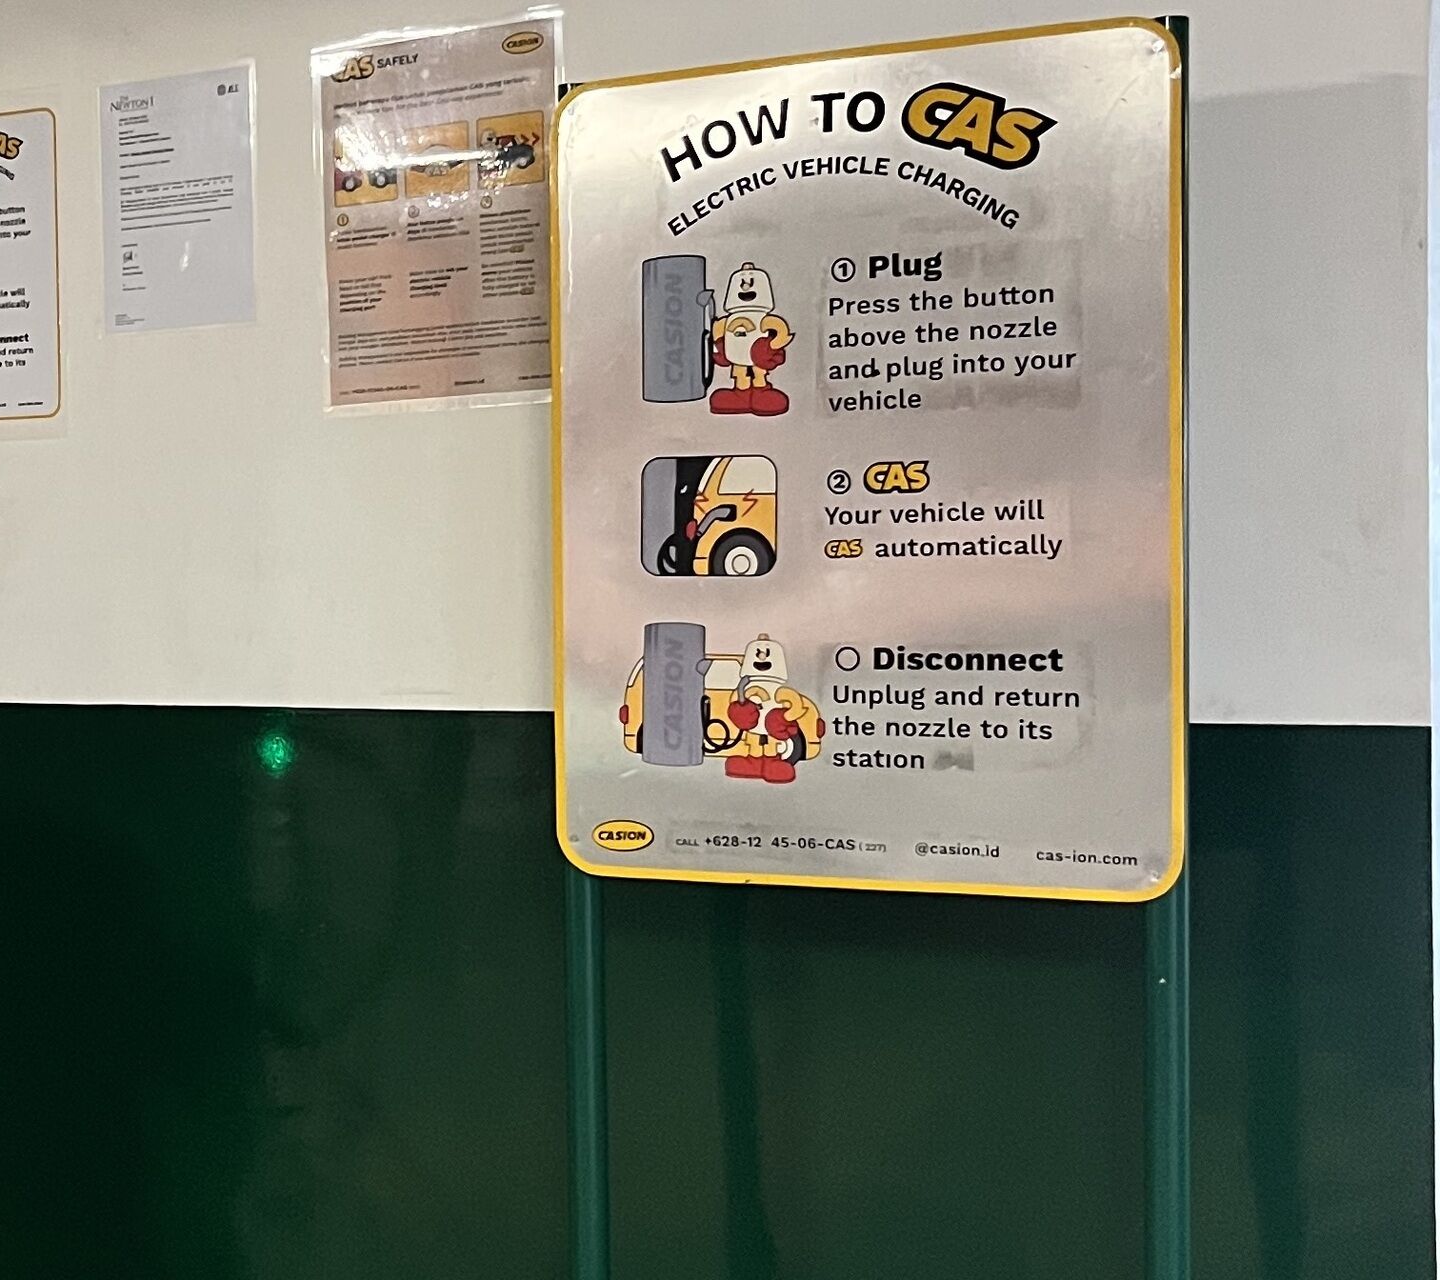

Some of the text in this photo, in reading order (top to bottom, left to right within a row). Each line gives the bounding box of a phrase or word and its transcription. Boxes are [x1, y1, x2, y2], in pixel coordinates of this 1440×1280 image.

[377, 53, 419, 69] SAFELY
[660, 82, 1058, 183] HOW TO CAS
[667, 155, 1020, 237] ELECTRIC VEHICLE CHARGING
[13, 229, 31, 239] your
[869, 251, 943, 282] Plug
[828, 286, 1055, 317] Press the button
[828, 316, 1058, 349] above the nozzle
[8, 347, 34, 356] return
[828, 350, 1077, 383] and plug into your
[828, 389, 922, 412] vehicle
[863, 460, 930, 494] CAS
[824, 499, 1045, 527] Your vehicle will
[824, 533, 1062, 560] CAS automatically
[873, 646, 1064, 673] Disconnect
[832, 684, 1081, 710] Unplug and return
[832, 716, 1053, 741] the nozzle to its
[832, 749, 925, 770] station
[597, 830, 647, 842] CASION
[675, 838, 700, 847] CALL
[1036, 849, 1138, 867] cas-ion.com
